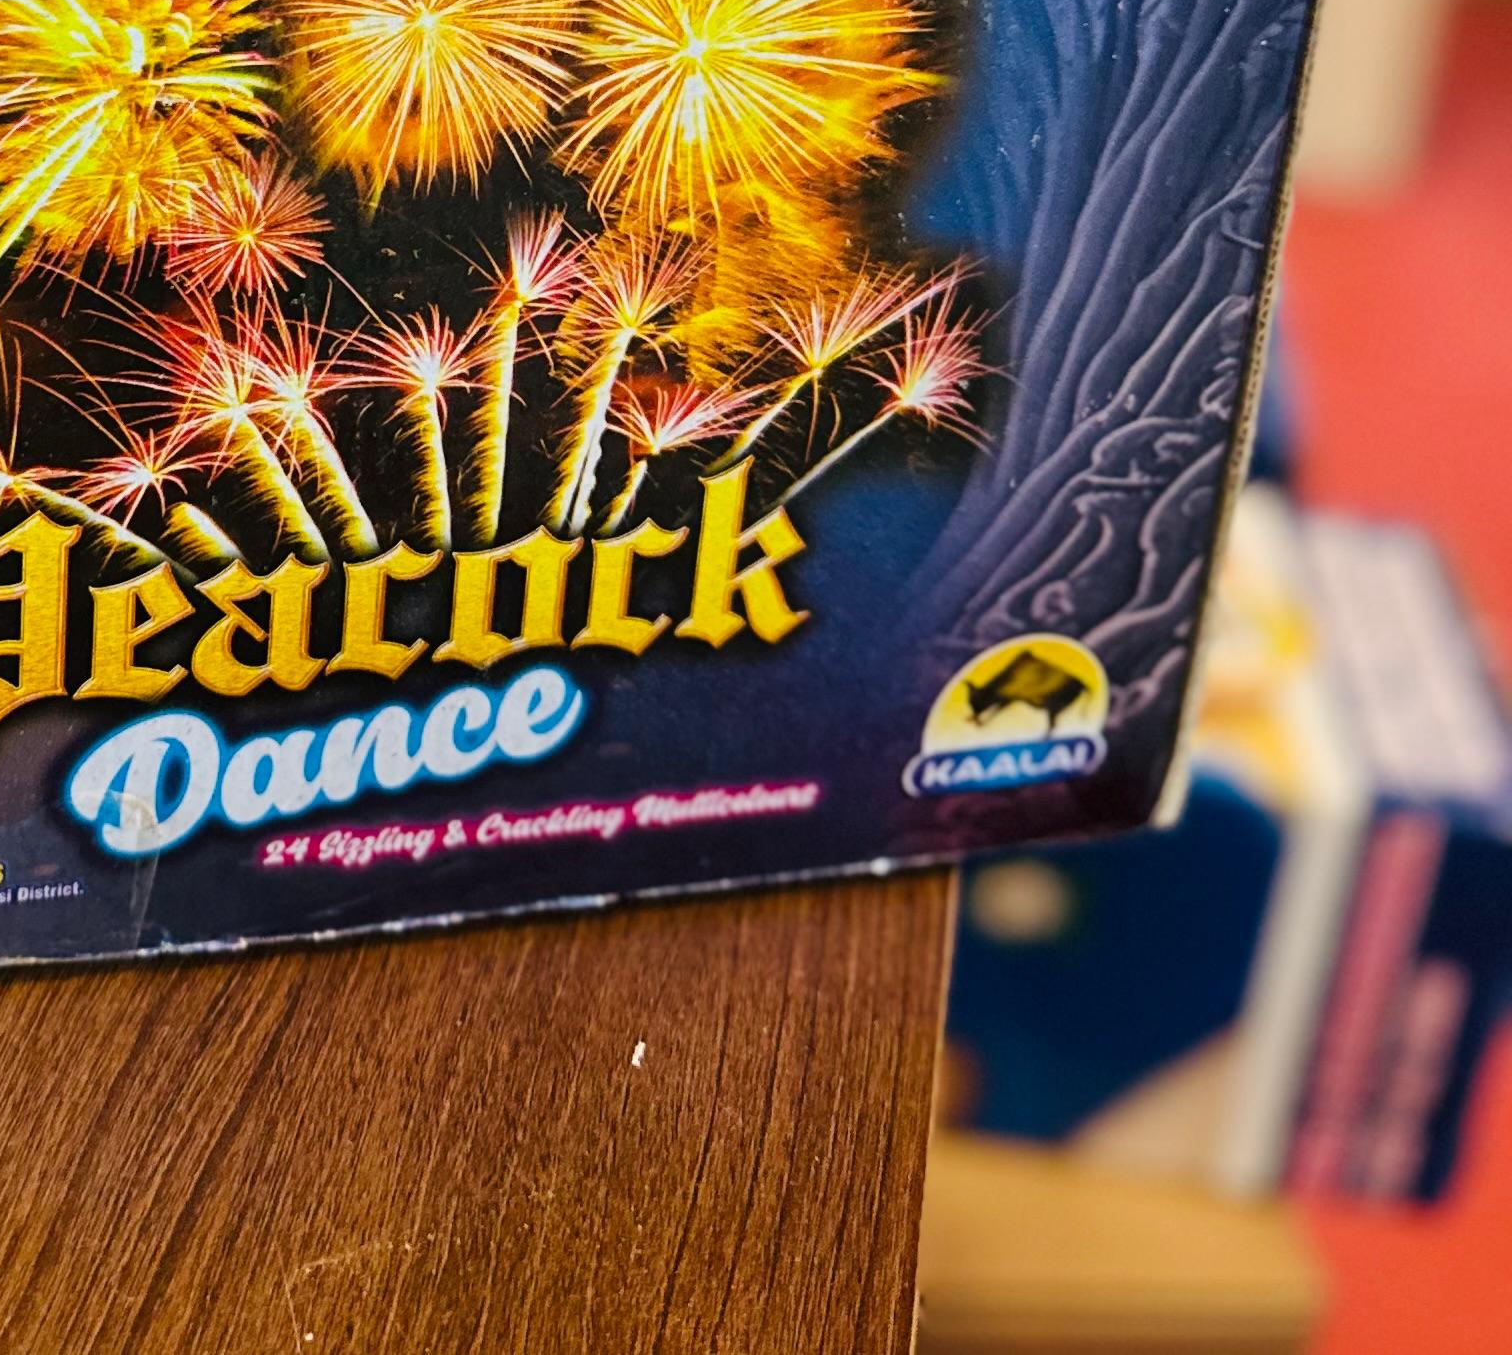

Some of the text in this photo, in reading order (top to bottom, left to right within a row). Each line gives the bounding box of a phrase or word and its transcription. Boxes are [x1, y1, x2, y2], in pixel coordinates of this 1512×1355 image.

[71, 670, 583, 852] Dance
[921, 741, 1088, 787] KAALAI
[263, 837, 310, 866] 24
[443, 819, 466, 848] &
[17, 880, 85, 902] District.
